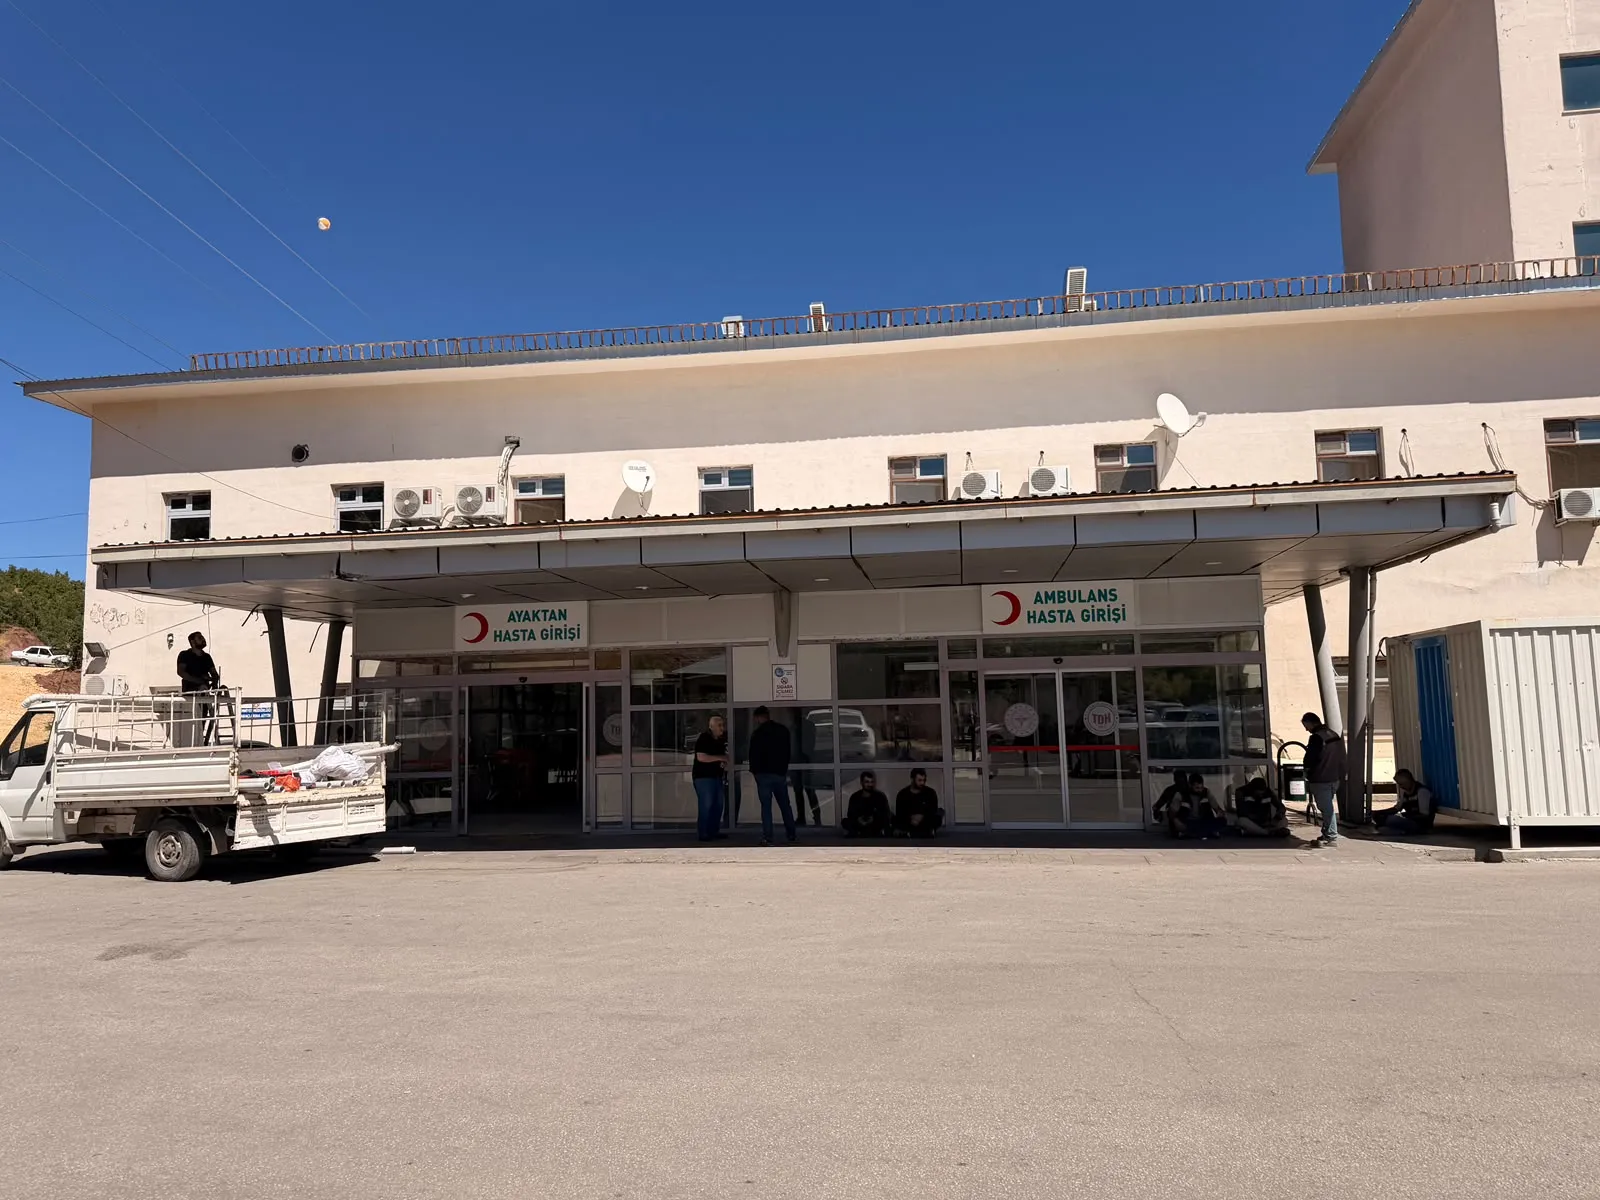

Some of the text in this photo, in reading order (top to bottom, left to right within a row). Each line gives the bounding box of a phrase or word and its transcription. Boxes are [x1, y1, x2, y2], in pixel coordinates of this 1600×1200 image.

[1034, 588, 1118, 604] AMBULANS
[507, 608, 567, 623] AYAKTAN
[1026, 604, 1126, 624] HASTA GİRİŞİ
[493, 623, 581, 642] HASTA GİRİŞİ
